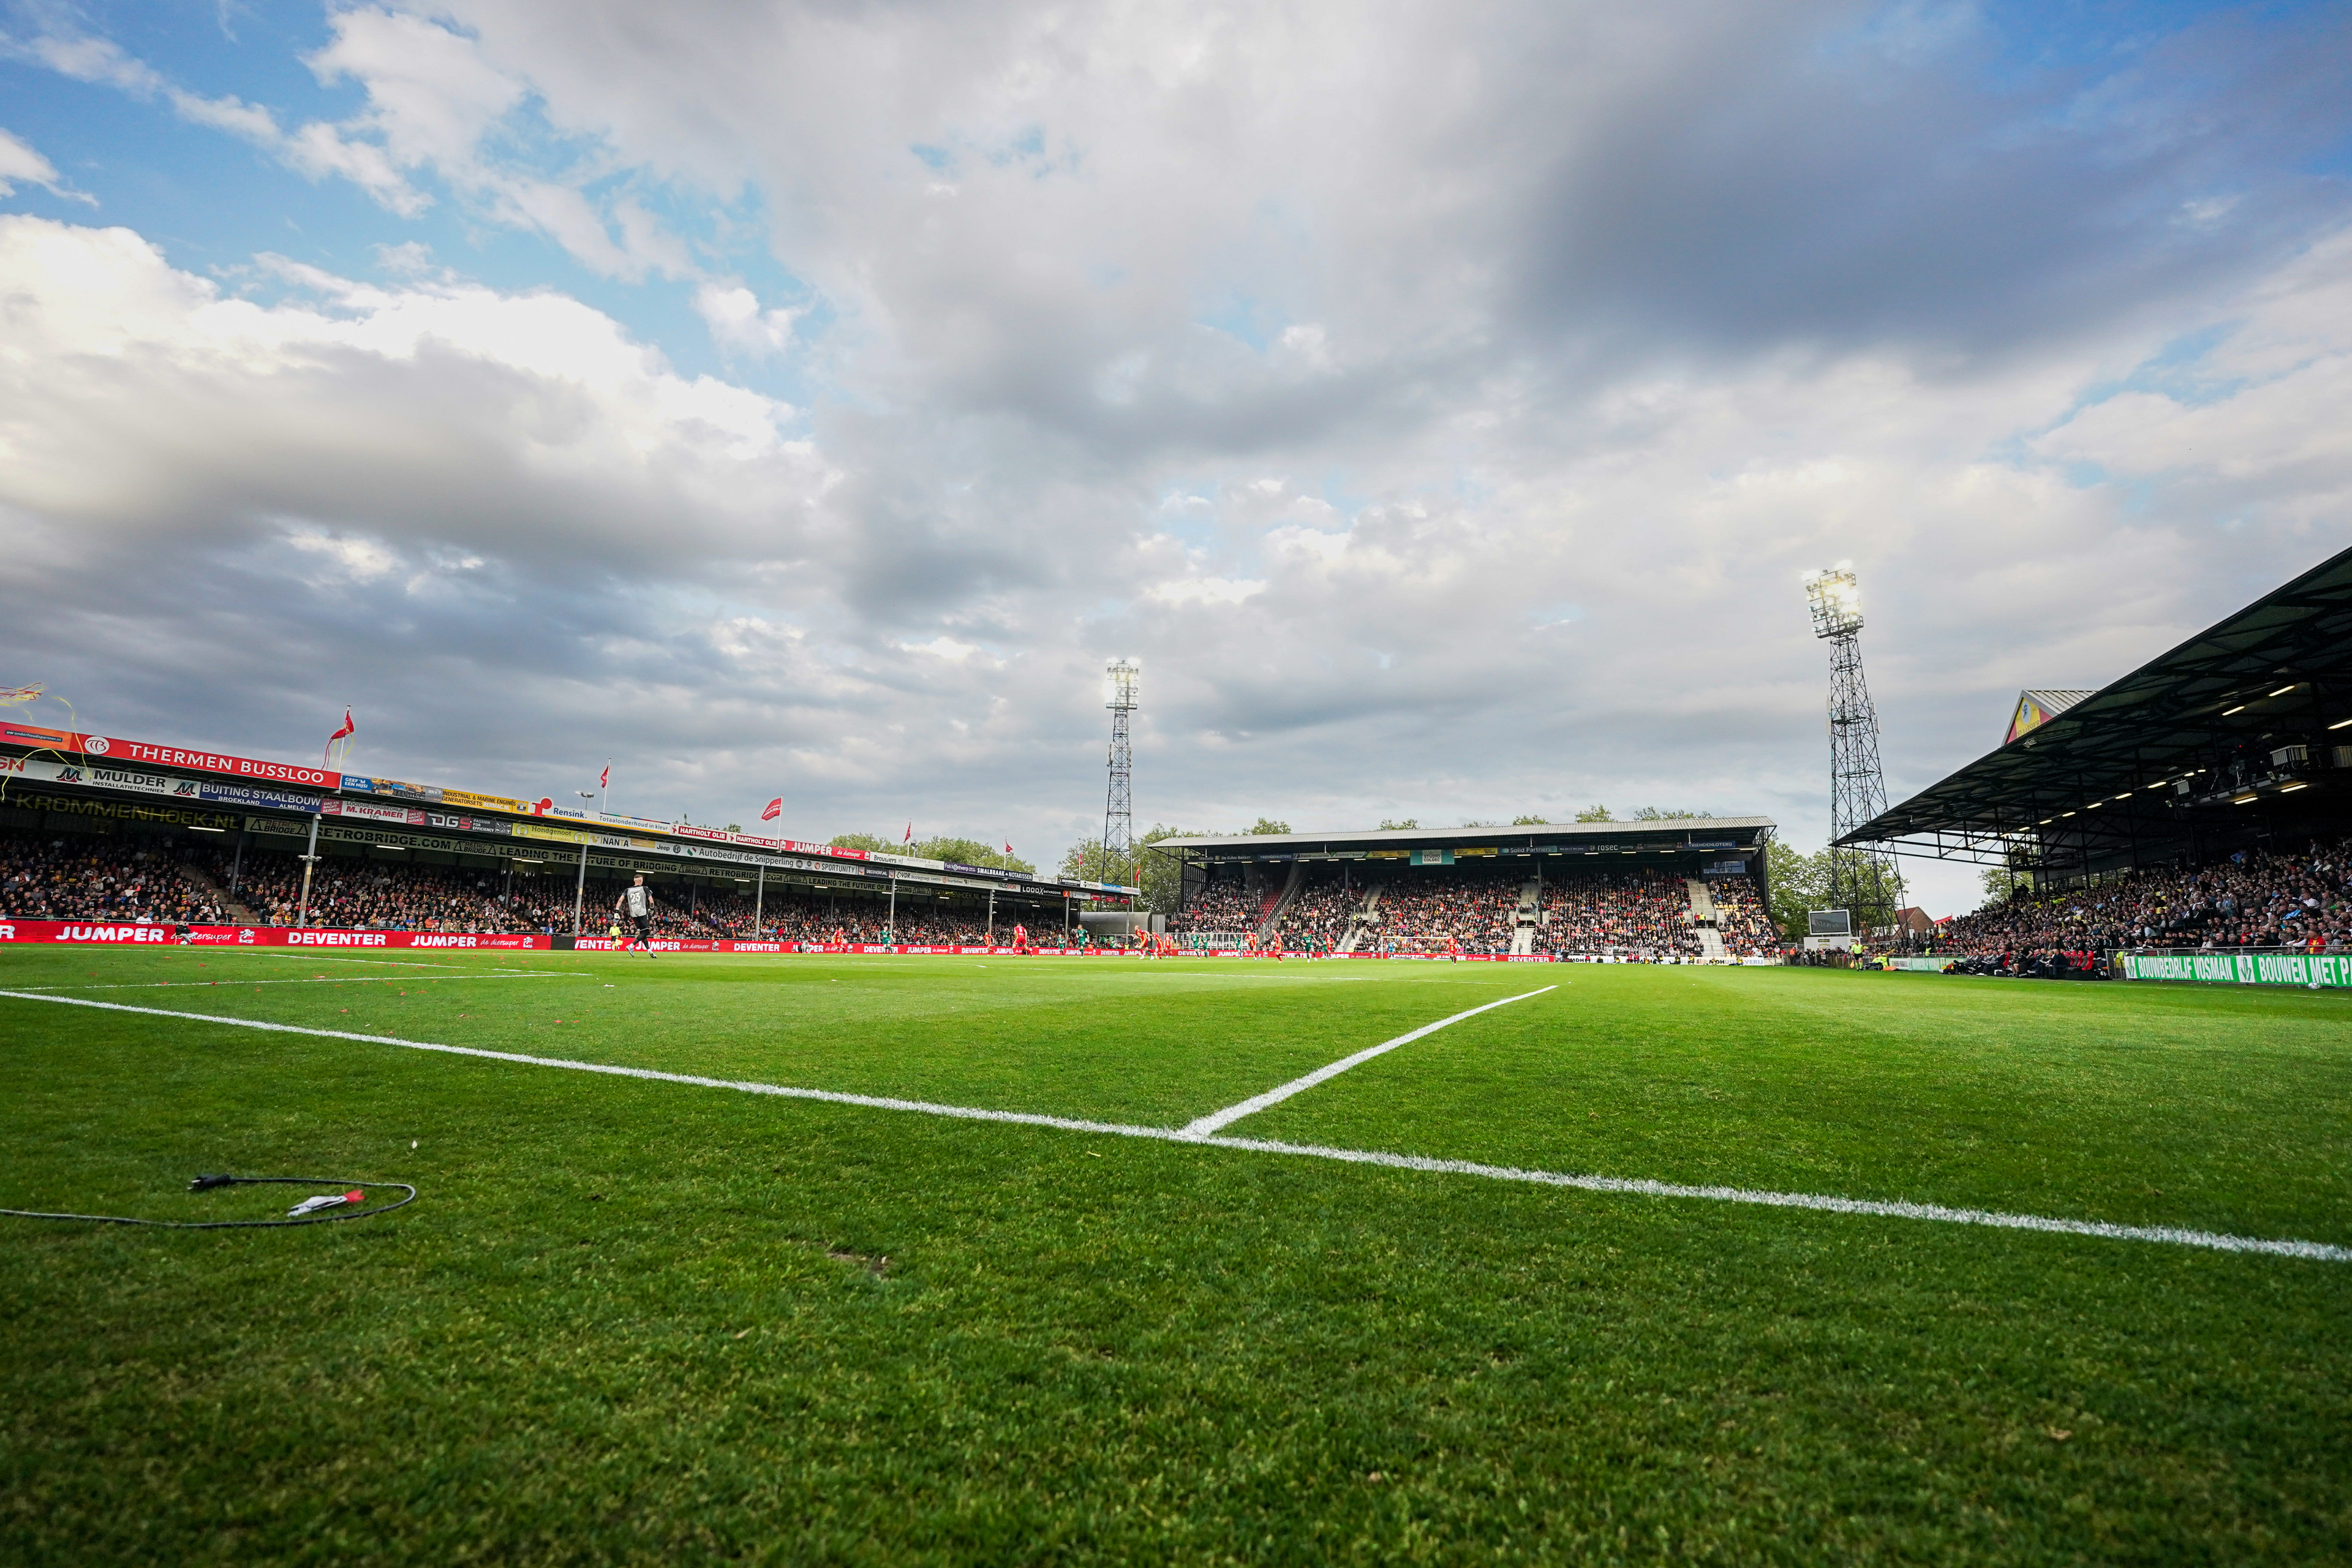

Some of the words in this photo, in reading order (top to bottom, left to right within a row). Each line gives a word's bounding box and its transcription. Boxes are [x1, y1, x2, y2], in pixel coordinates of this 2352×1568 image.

[129, 744, 232, 771] THERMEN
[240, 761, 324, 783] BUSSLOO
[94, 770, 166, 788] MULDER
[92, 781, 165, 793] INSTALLATIETECHNIEK
[202, 784, 250, 797] BUITING
[252, 791, 321, 807] STAALBOUW
[218, 796, 260, 805] BROEKLAND
[442, 791, 470, 799] INDUSTRIAL
[347, 802, 404, 812] LOODGIETERSBEDRIJF
[442, 796, 482, 806] GENERATORSETS
[483, 802, 510, 810] BERMAC.NL
[359, 807, 404, 819] KRAMER
[553, 807, 587, 819] Rensink.
[600, 816, 649, 828] Totaalonderhoud
[532, 826, 571, 836] Hondgenoot
[680, 827, 711, 837] HARTHOLT
[317, 827, 450, 850] RETROBRIDGE.COM
[603, 837, 629, 847] NANTA
[737, 835, 764, 845] HARTHOLT
[791, 842, 832, 856] JUMPER
[499, 846, 549, 859] LEADING
[552, 853, 573, 862] THE
[633, 861, 677, 872] BRIDGING
[699, 848, 743, 862] Autobedrijf
[755, 854, 794, 867] Snipperling
[873, 854, 897, 864] Brouwers
[821, 863, 855, 873] SPORTUNITY
[977, 867, 1005, 876] SMALBRAAK
[1008, 872, 1033, 880] NOTARISSEN
[709, 869, 782, 881] RETROBRIDG.COM
[809, 878, 837, 886] LEADING
[630, 892, 641, 903] 23
[56, 926, 165, 942] JUMPER
[193, 933, 233, 943] ersuper
[288, 932, 386, 945] DEVENTER
[410, 935, 477, 947] JUMPER
[491, 939, 519, 949] diersuper
[734, 943, 780, 952] DEVENTER
[2137, 957, 2192, 979] BOUWBEDRIJF
[2193, 957, 2234, 981] VOSMAN
[2258, 957, 2309, 983] BOUWEN
[2309, 957, 2336, 985] MET
[2339, 957, 2352, 985] P
